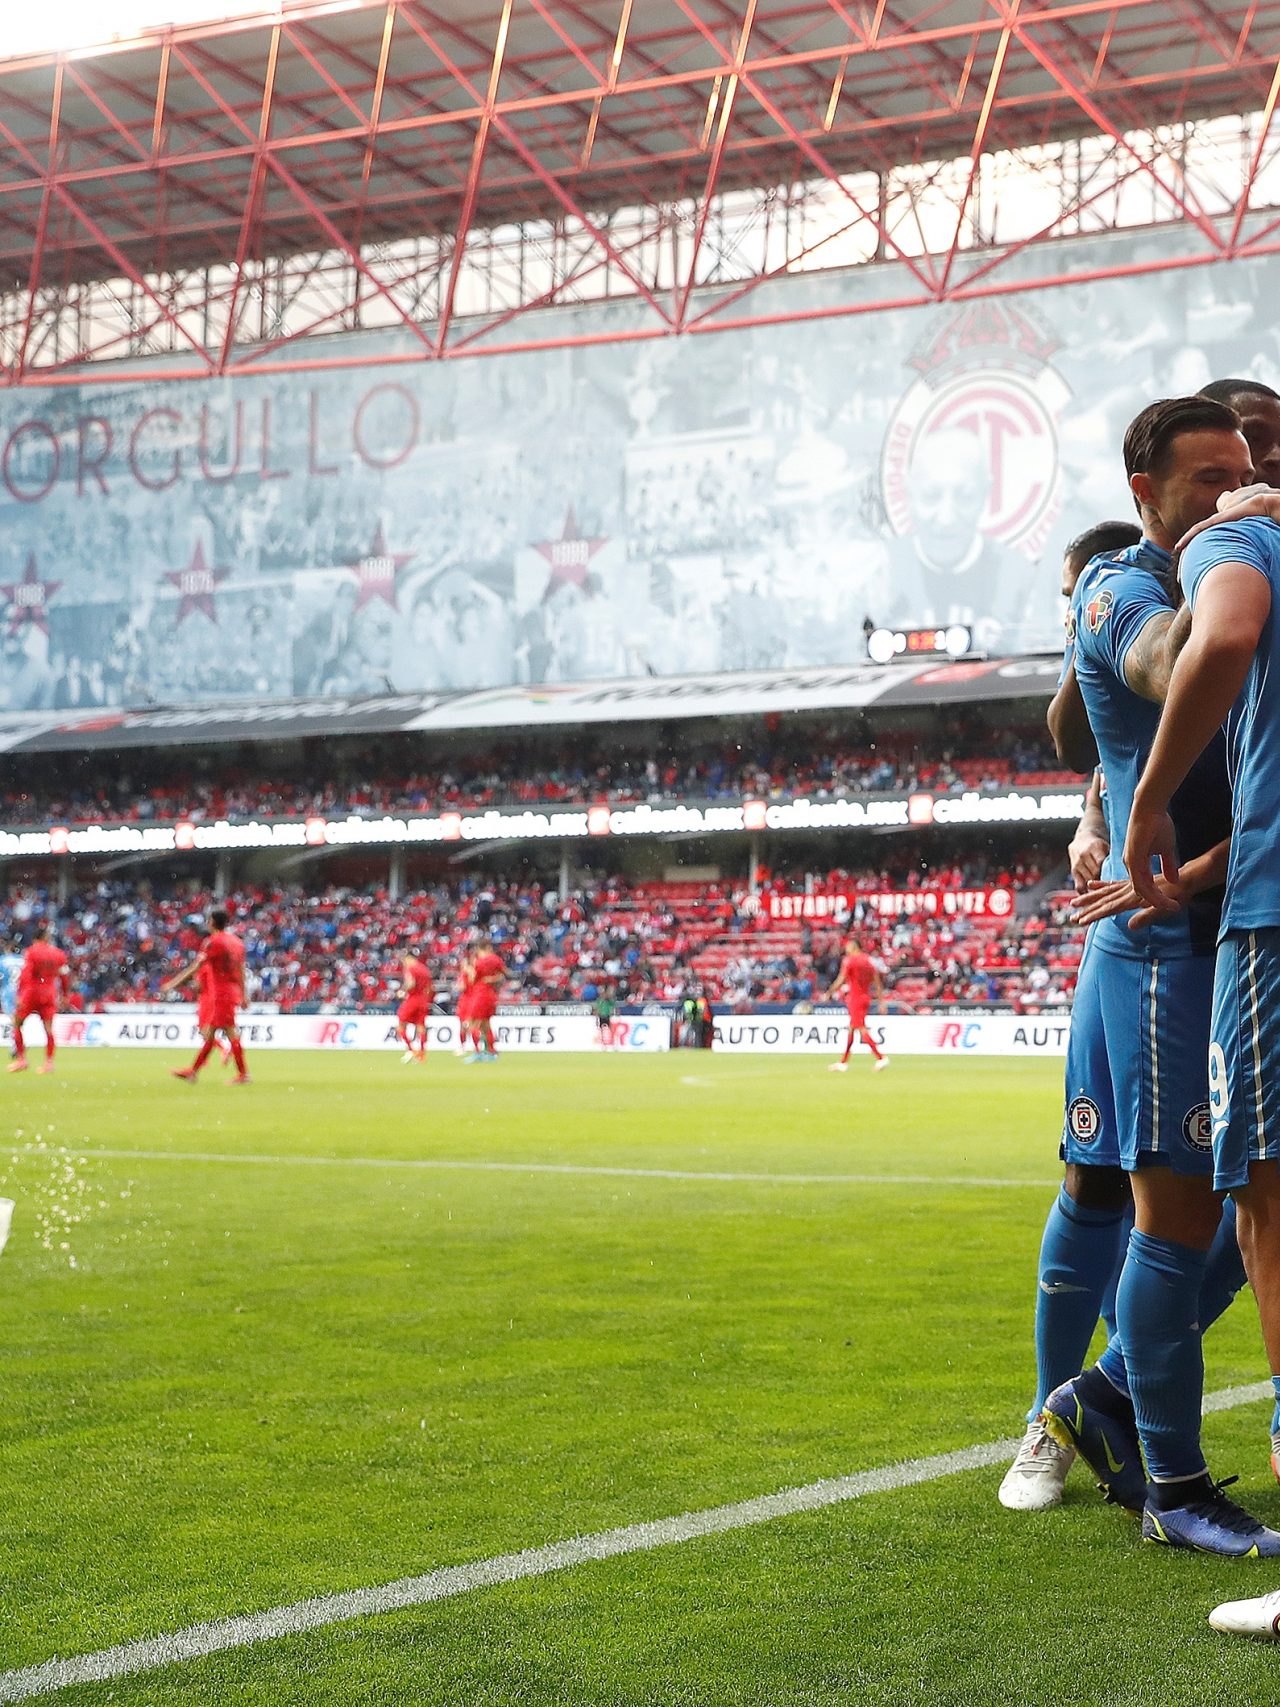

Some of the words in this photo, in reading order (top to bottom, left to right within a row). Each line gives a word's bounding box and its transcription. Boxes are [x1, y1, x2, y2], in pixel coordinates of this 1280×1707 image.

[3, 381, 420, 502] ORGULLO
[119, 1024, 180, 1041] AUTO
[313, 1022, 359, 1044] RC
[712, 1026, 779, 1044] AUTO
[934, 1023, 982, 1048] RC
